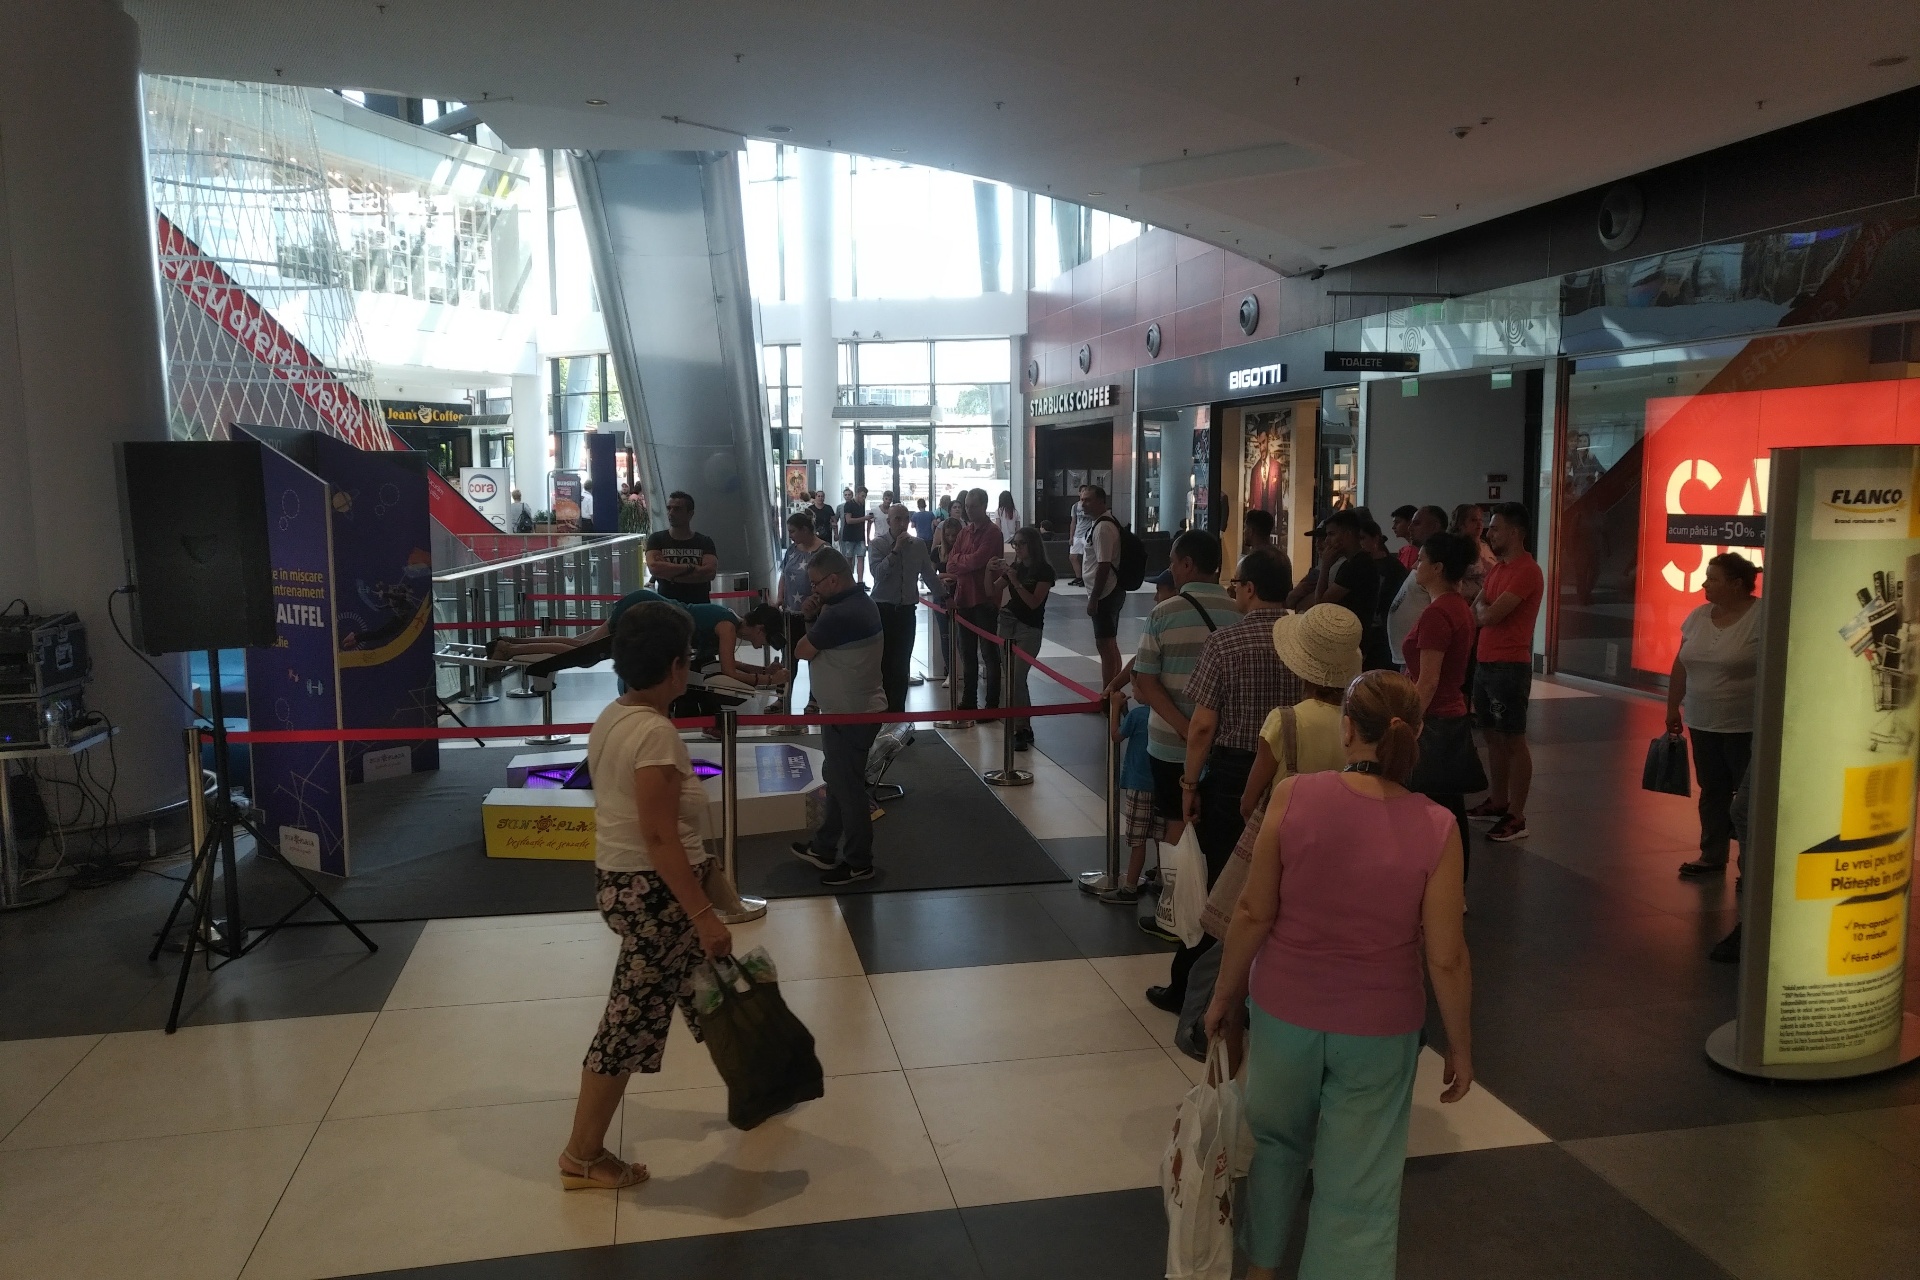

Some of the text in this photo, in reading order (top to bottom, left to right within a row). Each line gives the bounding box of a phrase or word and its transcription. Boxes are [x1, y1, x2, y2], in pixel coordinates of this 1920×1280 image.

[230, 309, 306, 380] oferta
[1340, 357, 1382, 367] TOALETE
[1229, 364, 1281, 390] BIGOTTI
[1030, 385, 1110, 417] STARBUCKS COFFEE
[387, 407, 418, 420] Jean's
[469, 483, 494, 493] cora
[1831, 489, 1903, 504] FLANCO
[1668, 527, 1688, 535] acum
[1689, 525, 1709, 538] până
[1710, 526, 1717, 536] la
[1719, 521, 1755, 540] -50%
[276, 603, 325, 628] ALTFEL
[554, 820, 596, 832] PLAZ
[1835, 858, 1849, 872] Le
[1852, 855, 1872, 870] vrei
